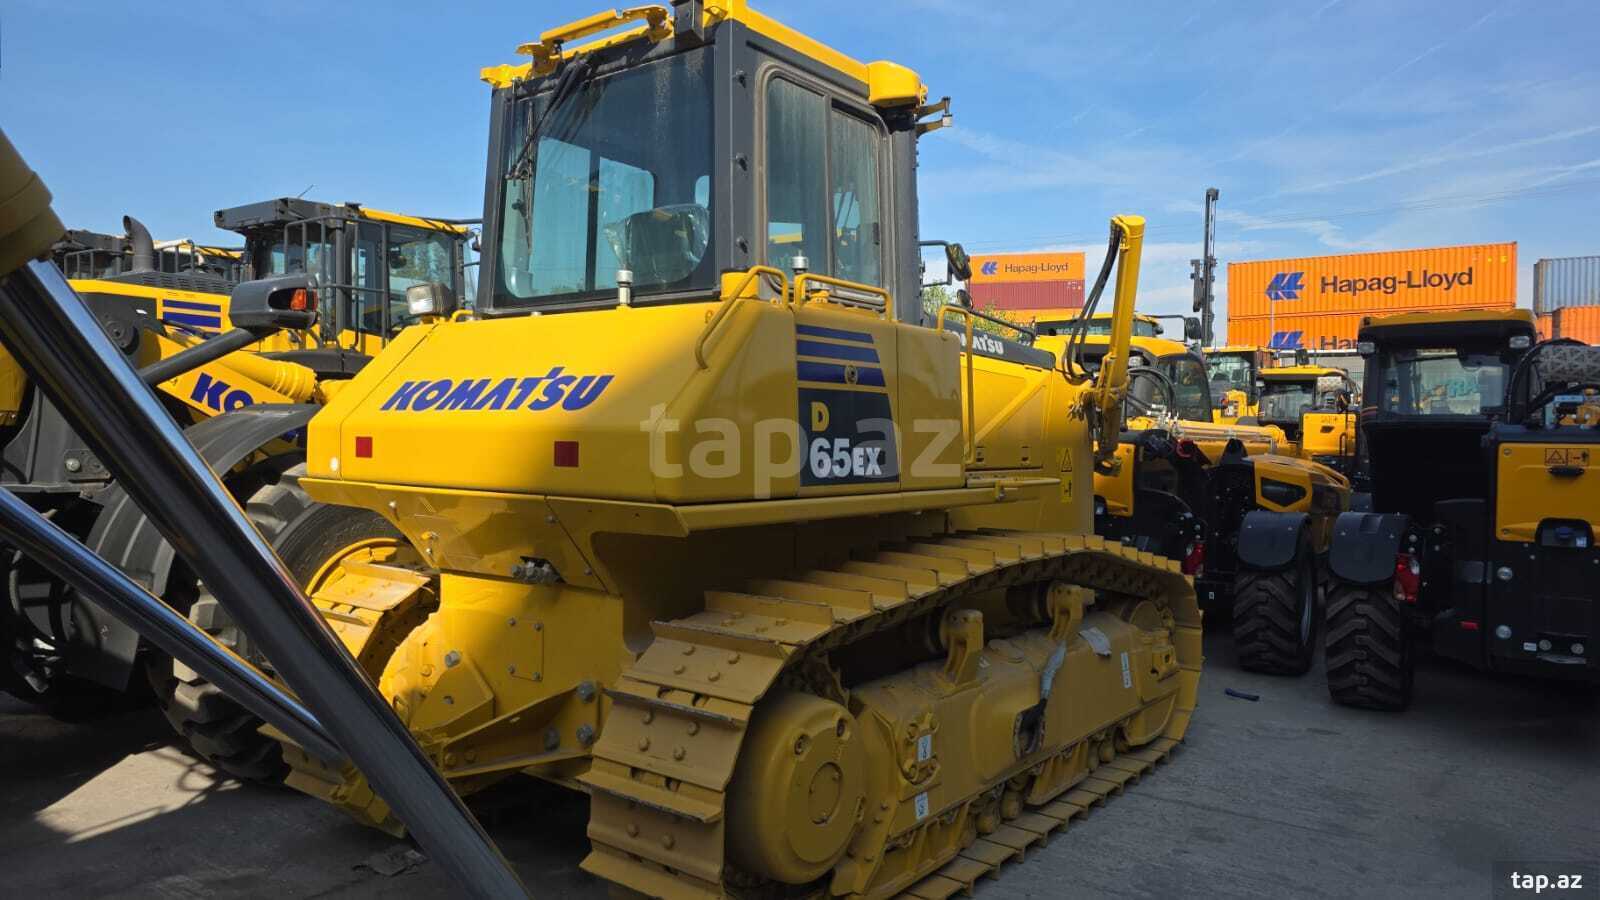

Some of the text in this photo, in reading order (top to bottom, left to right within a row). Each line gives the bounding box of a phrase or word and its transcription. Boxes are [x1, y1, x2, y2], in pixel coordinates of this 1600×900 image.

[1004, 262, 1069, 273] Hapag-Lloyd
[1320, 267, 1474, 296] Hapag-Lloyd
[190, 372, 254, 412] KO
[380, 367, 615, 411] KOMATSU
[811, 402, 830, 432] D
